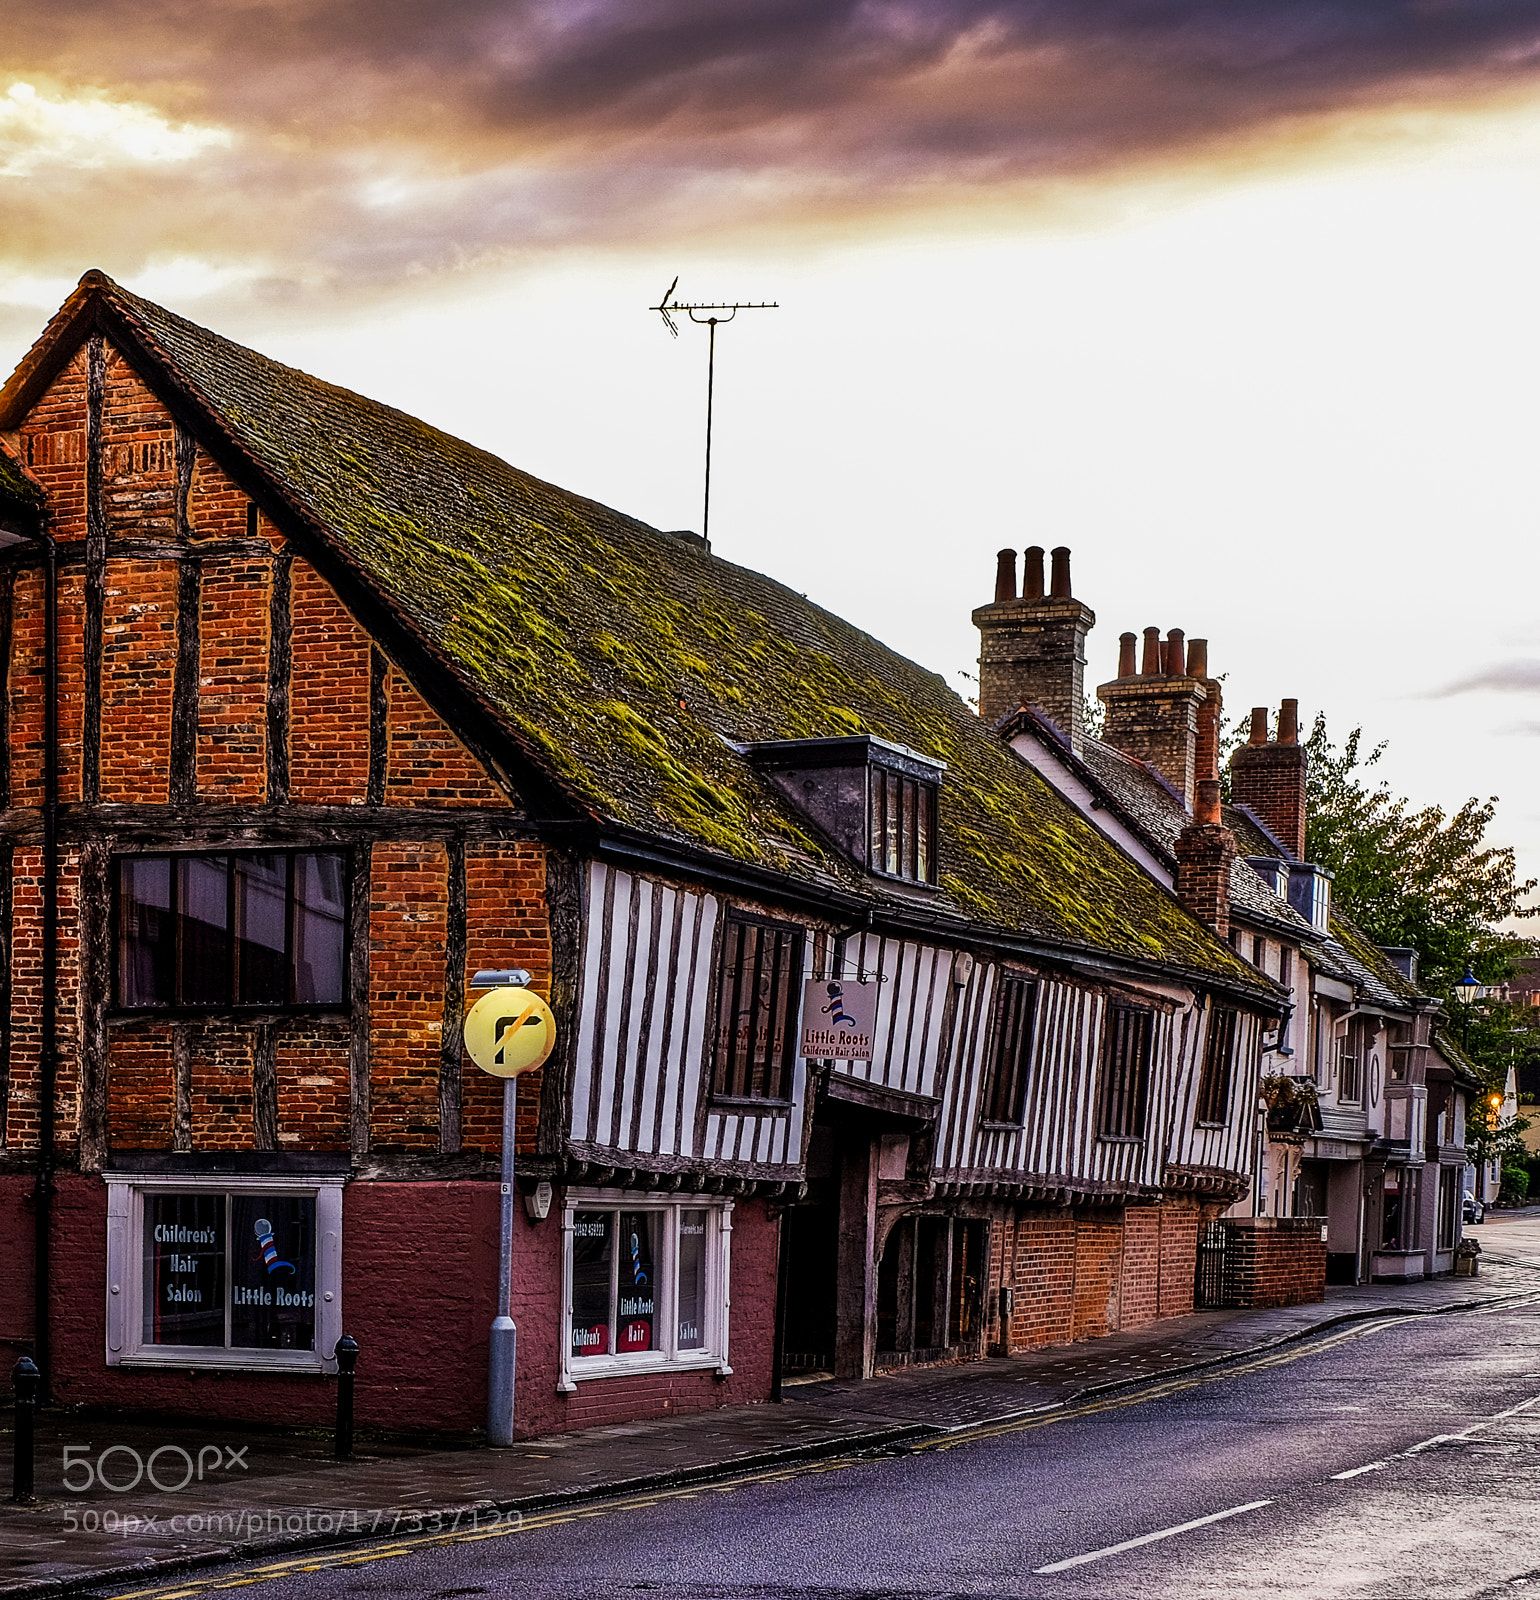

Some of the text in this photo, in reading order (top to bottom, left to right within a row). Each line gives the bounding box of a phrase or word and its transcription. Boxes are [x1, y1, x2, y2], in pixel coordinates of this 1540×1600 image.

[805, 1029, 869, 1046] Little Roots
[802, 1045, 870, 1057] Children's Hair Salon
[502, 1184, 508, 1193] 6
[154, 1224, 216, 1244] Children's
[169, 1254, 199, 1273] Hair
[166, 1283, 202, 1302] Salon
[234, 1286, 314, 1308] Little Roots
[620, 1296, 654, 1316] Little Roots
[572, 1324, 698, 1347] Children's Hair Salon
